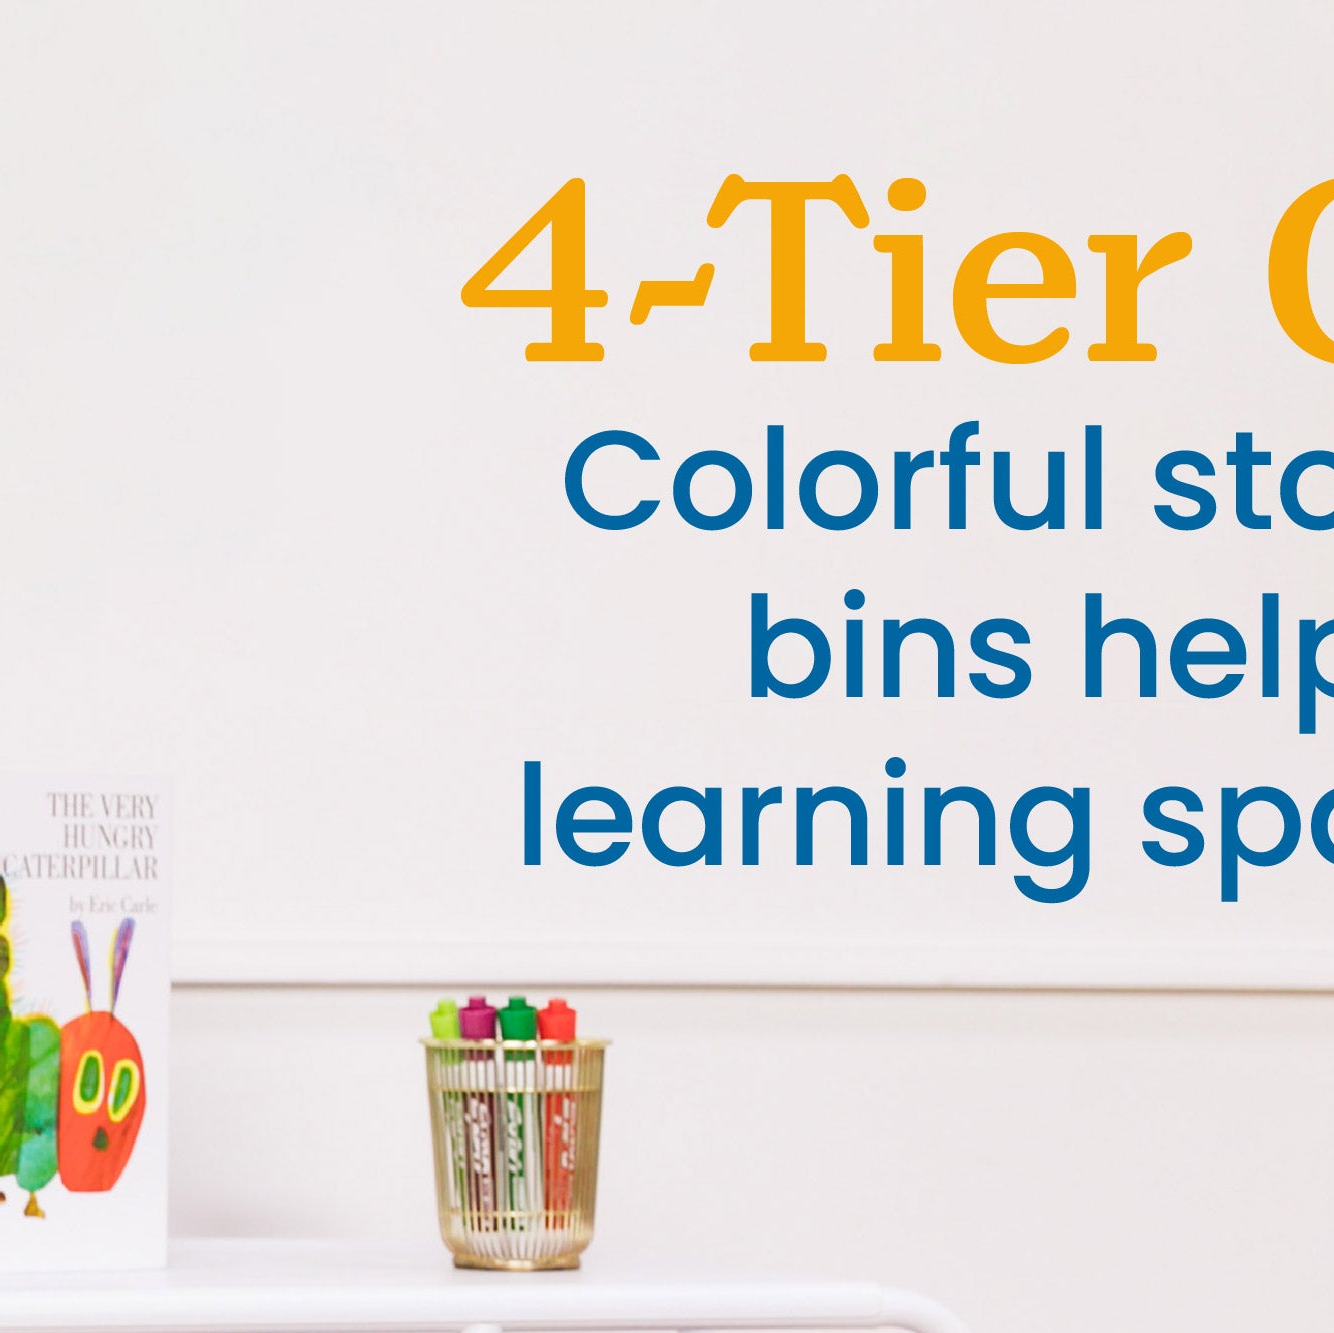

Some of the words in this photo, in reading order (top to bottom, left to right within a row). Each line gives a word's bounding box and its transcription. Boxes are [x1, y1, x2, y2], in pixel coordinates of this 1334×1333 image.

[47, 792, 94, 818] THE
[100, 793, 159, 820] VERY
[64, 823, 159, 849] HUNGRY
[3, 854, 159, 881] CATERPILLAR
[89, 896, 118, 913] Eric
[120, 897, 158, 914] Carle
